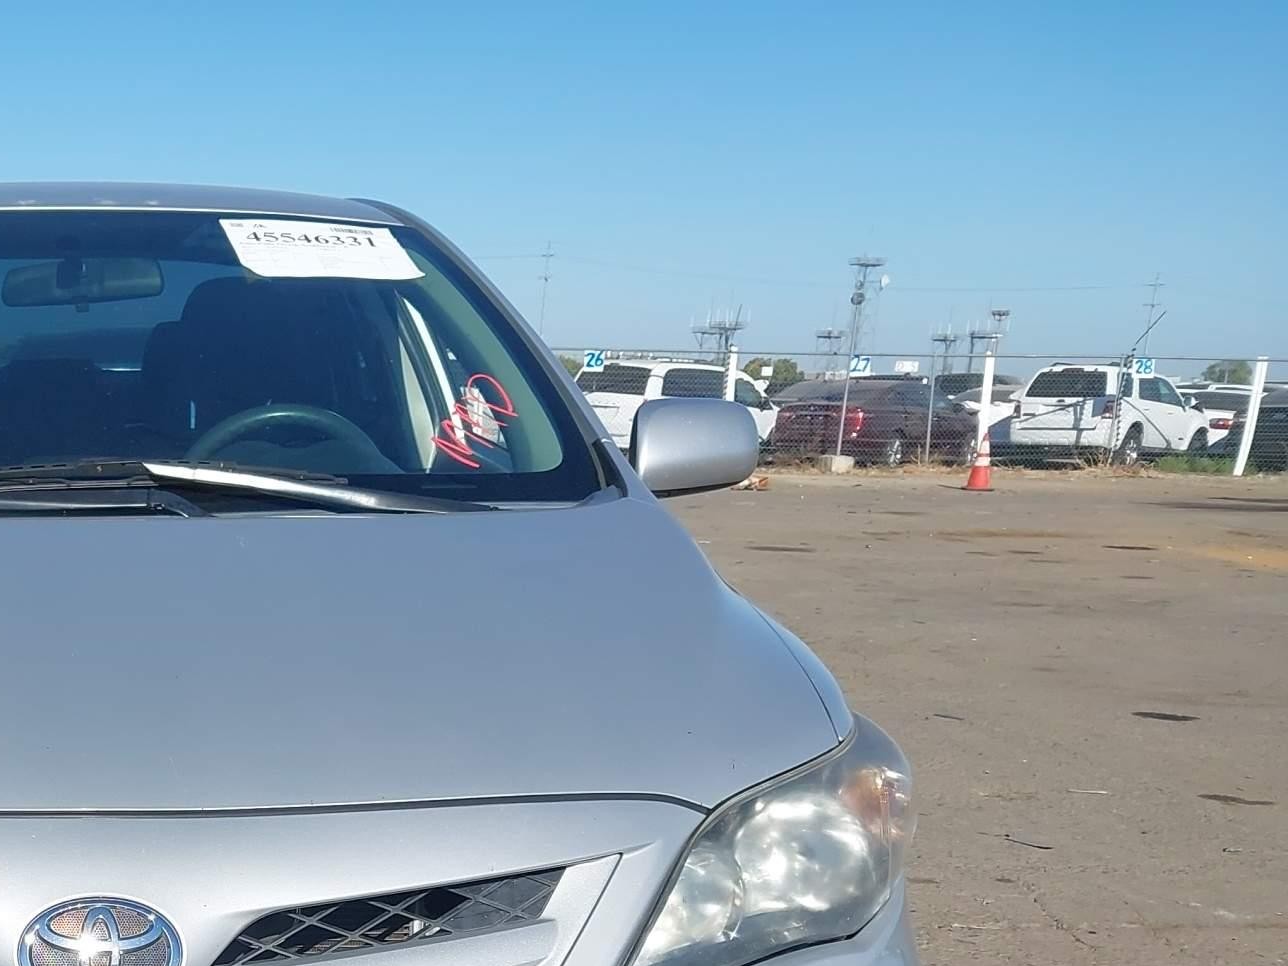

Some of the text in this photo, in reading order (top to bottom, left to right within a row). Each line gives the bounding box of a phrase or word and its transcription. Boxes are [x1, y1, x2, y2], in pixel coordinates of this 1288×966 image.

[246, 231, 377, 248] 45546331
[585, 350, 604, 367] 26
[850, 355, 870, 372] 27
[1135, 359, 1153, 374] 28
